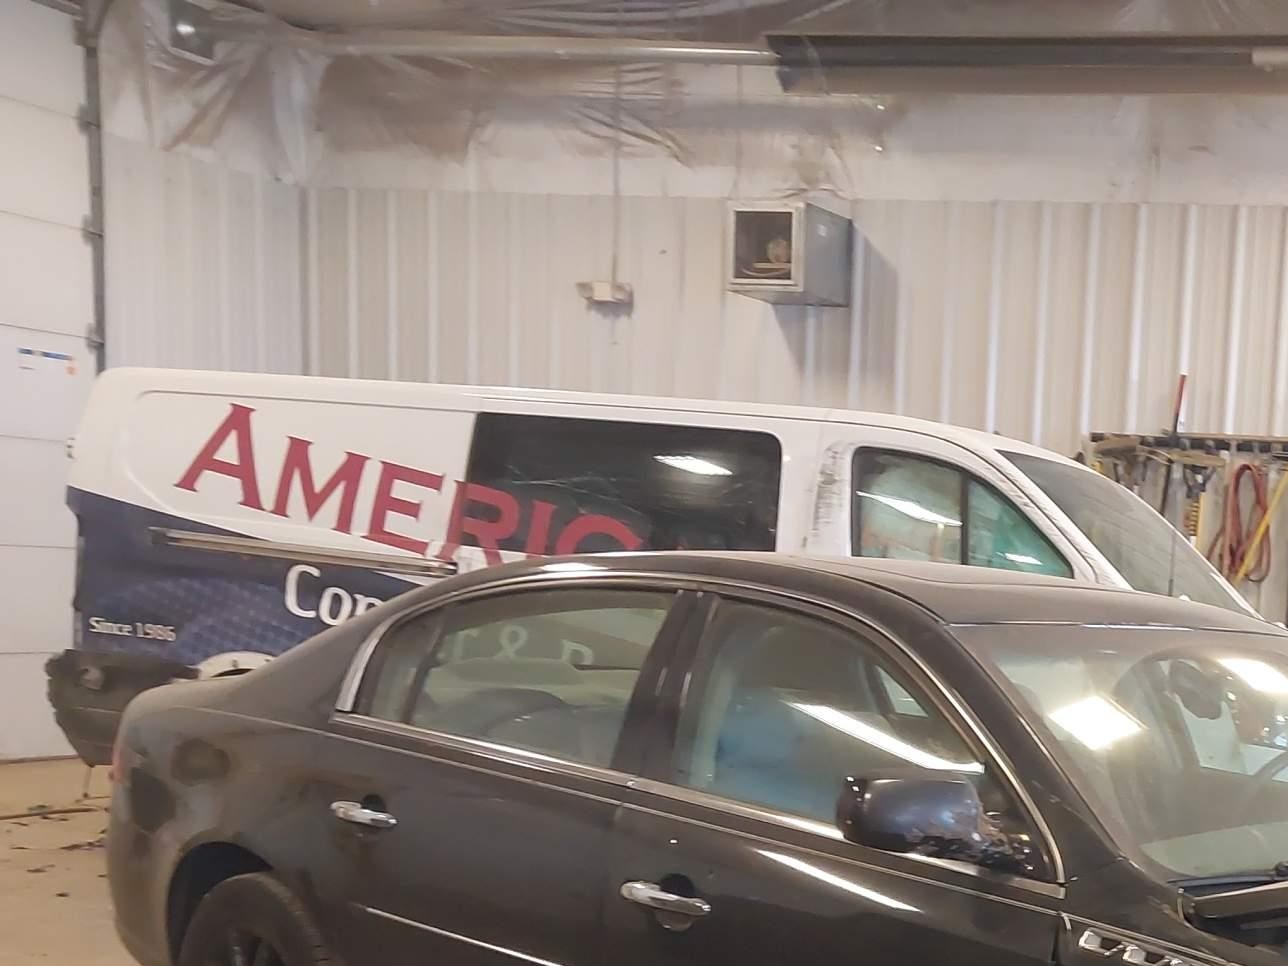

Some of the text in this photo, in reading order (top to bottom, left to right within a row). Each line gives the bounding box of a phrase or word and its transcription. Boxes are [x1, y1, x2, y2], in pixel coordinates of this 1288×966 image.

[173, 402, 688, 567] AMERIC
[88, 616, 177, 642] Since 1986
